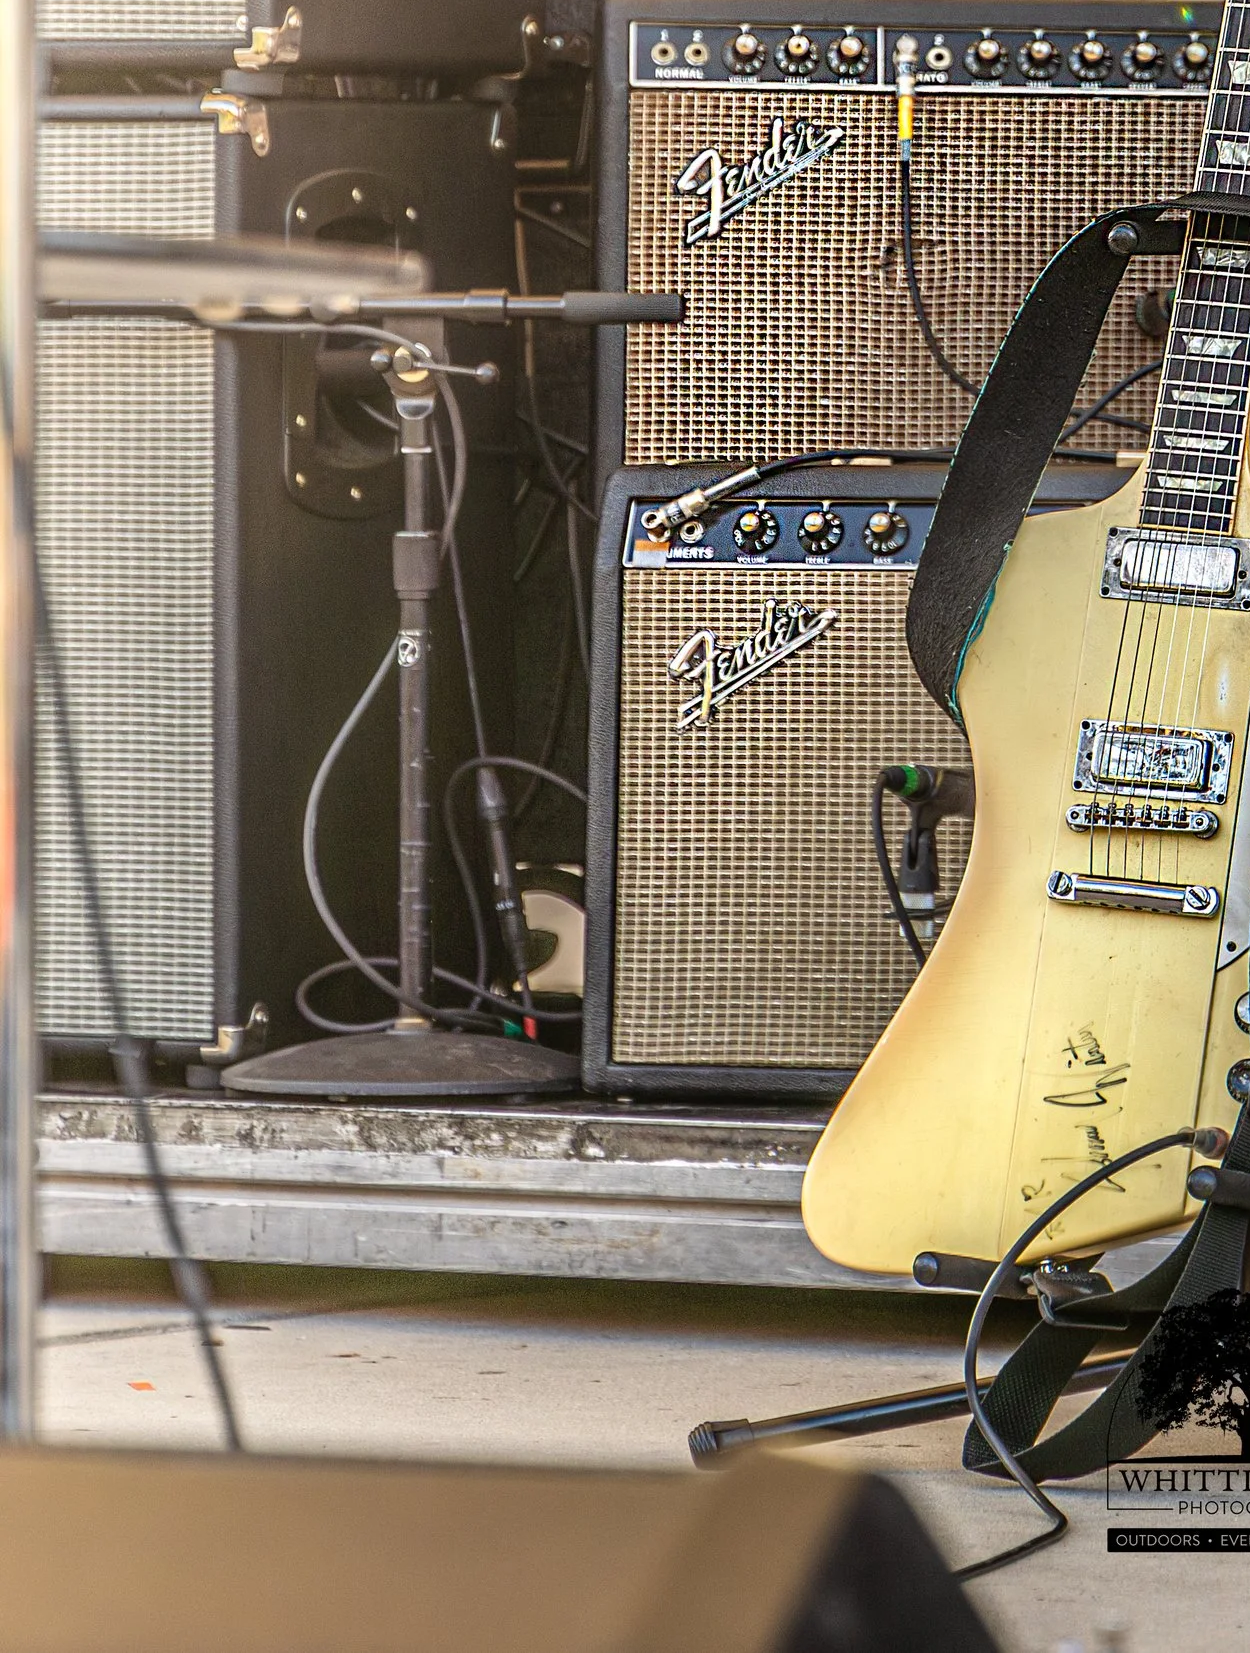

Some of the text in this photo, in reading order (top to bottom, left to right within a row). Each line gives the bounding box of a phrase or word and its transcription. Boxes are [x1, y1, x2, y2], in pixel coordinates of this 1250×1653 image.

[654, 66, 704, 79] NORMAL
[675, 117, 845, 244] Fender
[736, 555, 769, 565] VOLUME
[873, 556, 895, 565] BASS
[668, 598, 838, 733] Fender
